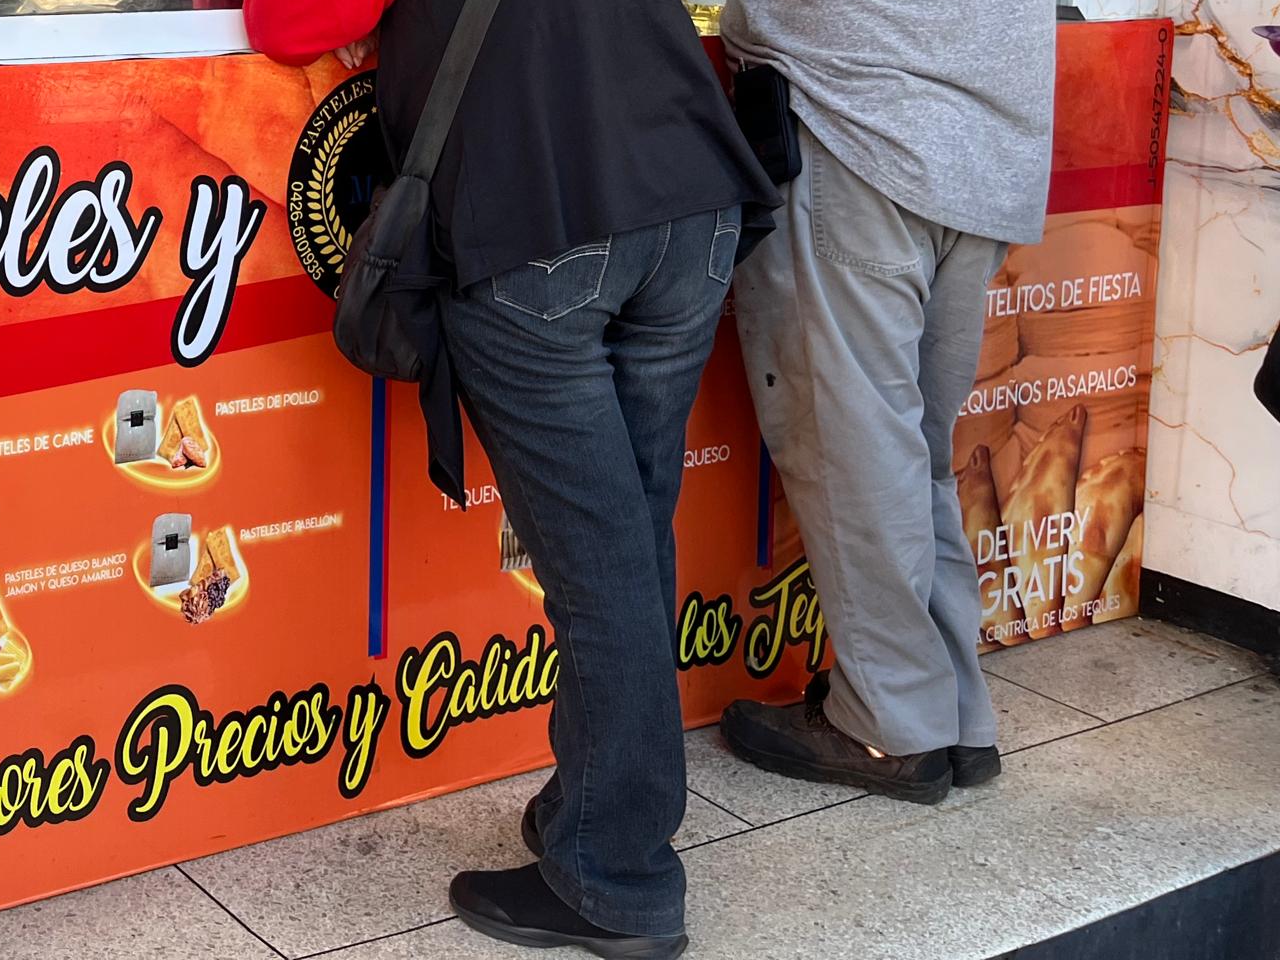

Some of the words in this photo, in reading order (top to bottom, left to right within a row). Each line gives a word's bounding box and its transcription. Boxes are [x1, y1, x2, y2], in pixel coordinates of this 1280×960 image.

[300, 77, 373, 155] PASTELES
[290, 180, 326, 282] 0426-6101935
[176, 175, 267, 365] y
[986, 282, 1055, 317] TELITOS
[1061, 278, 1084, 308] DE
[1088, 272, 1142, 304] FIESTA
[1046, 364, 1137, 401] PASAPALOS
[215, 396, 265, 416] PASTELES
[267, 394, 281, 409] DE
[283, 389, 319, 407] POLLO
[34, 435, 50, 451] DE
[53, 428, 94, 448] CARNE
[683, 444, 730, 469] QUESO
[240, 523, 280, 540] PASTELES
[282, 521, 293, 534] DE
[977, 506, 1090, 566] DELIVERY
[4, 567, 44, 584] PASTELES
[46, 564, 58, 576] DE
[59, 559, 90, 574] QUESO
[91, 553, 127, 569] BLANCO
[40, 580, 46, 591] Y
[48, 574, 79, 589] QUESO
[81, 566, 123, 584] AMARILLO
[977, 550, 1085, 617] GRATIS
[1042, 609, 1057, 628] DE
[1058, 604, 1079, 623] LOS
[1081, 594, 1121, 617] TEQUES
[123, 687, 335, 820] Precios
[342, 680, 389, 797] y
[397, 627, 559, 757] Calida
